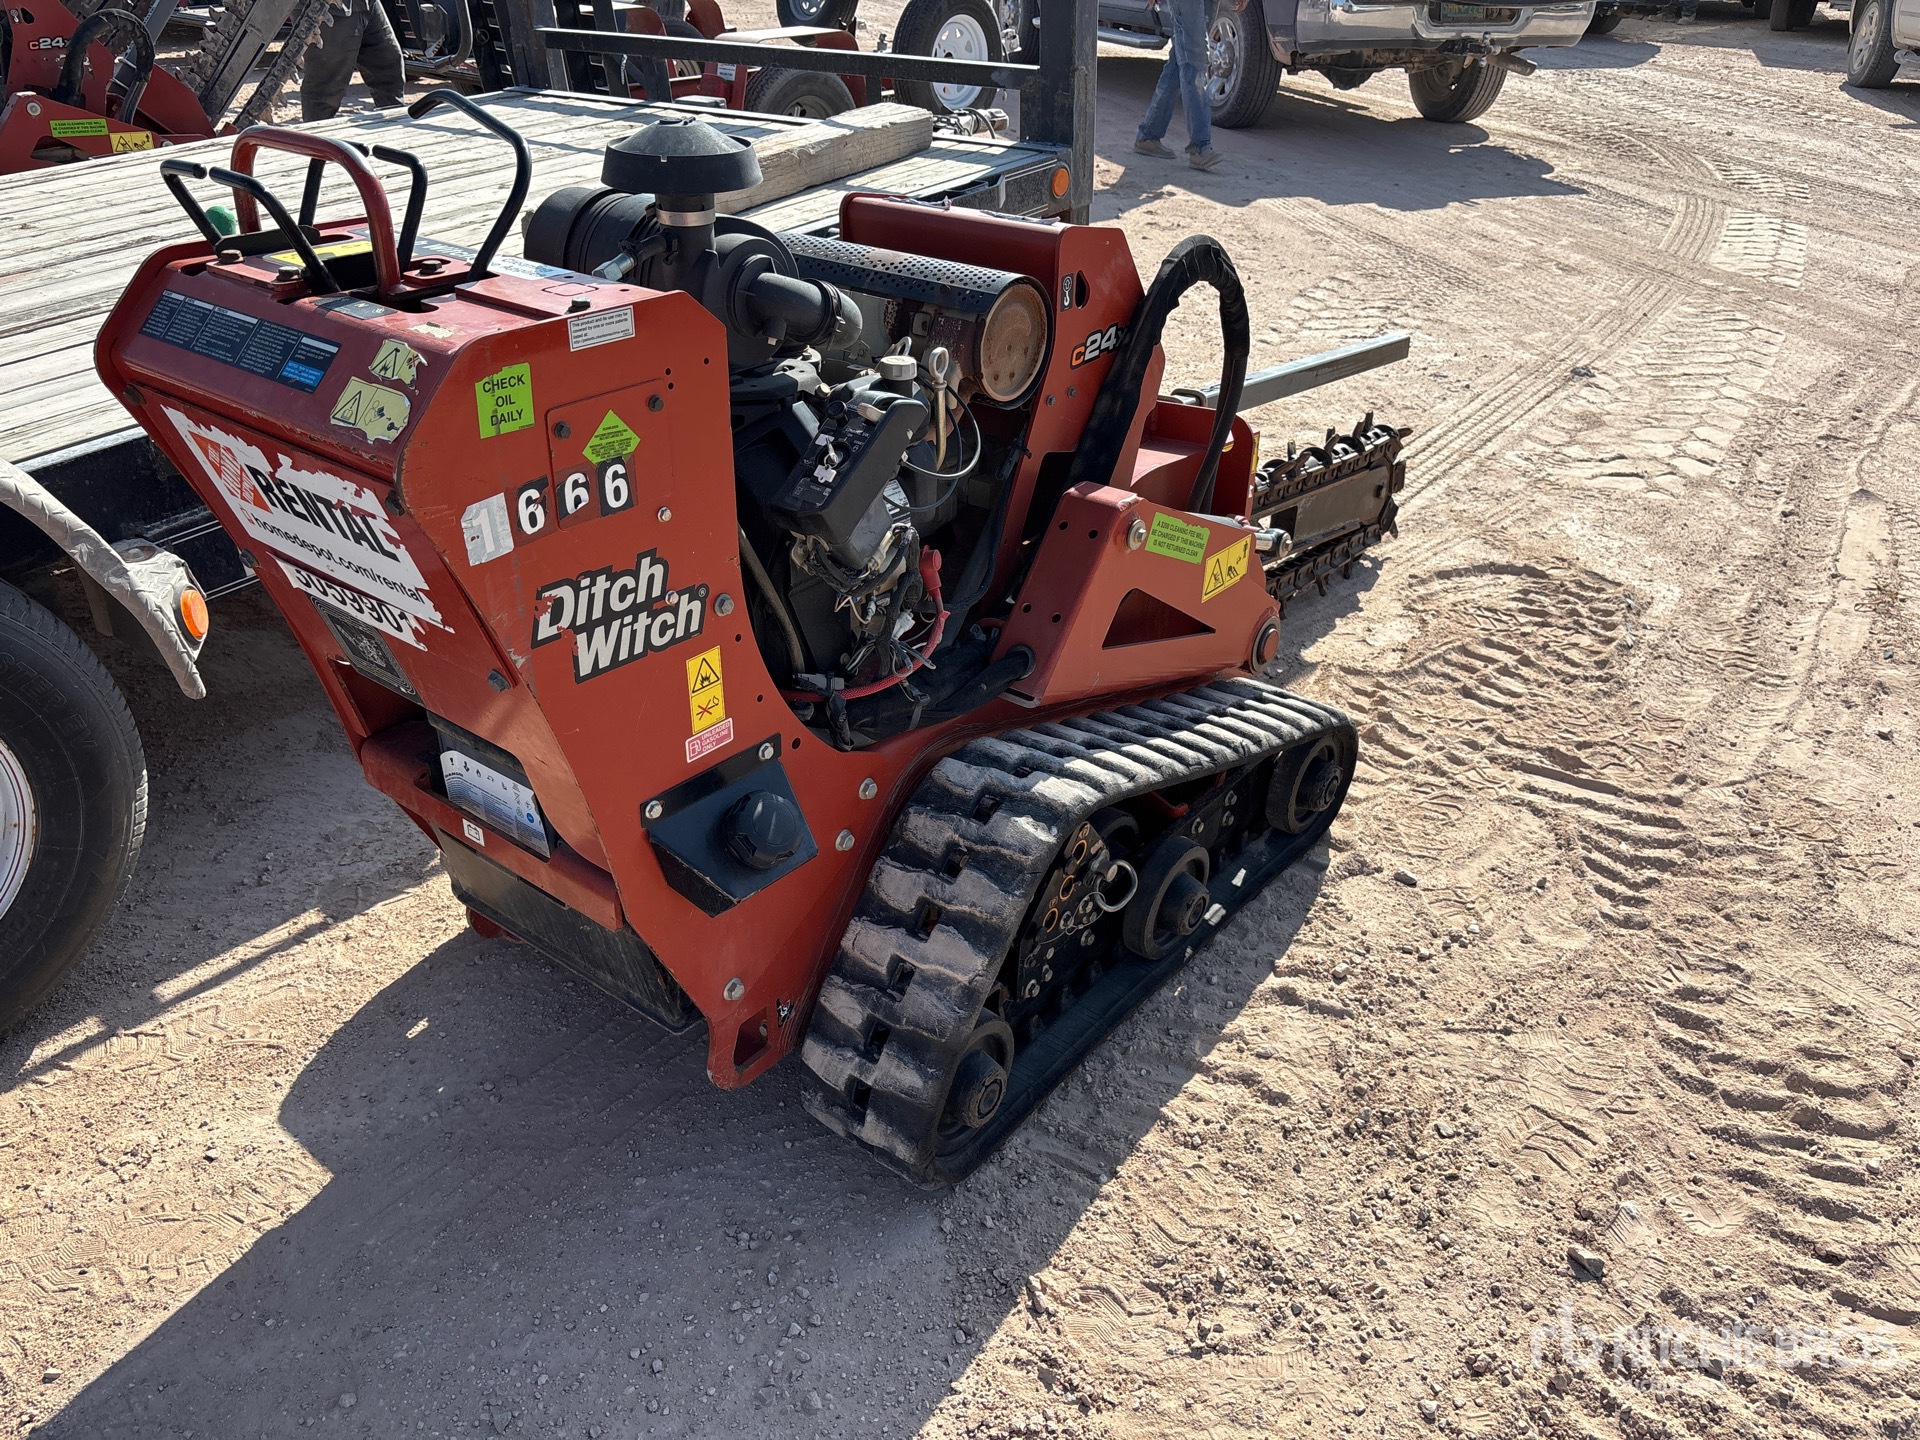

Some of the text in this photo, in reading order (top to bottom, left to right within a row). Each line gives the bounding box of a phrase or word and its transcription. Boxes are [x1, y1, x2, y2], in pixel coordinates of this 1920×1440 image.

[483, 374, 525, 393] CHECK
[496, 394, 516, 408] OIL
[491, 408, 524, 427] DAILY
[245, 464, 401, 562] RENTAL
[1157, 530, 1176, 541] CHARGED
[1179, 537, 1189, 545] THIS
[1188, 540, 1205, 550] MACHINE
[1169, 524, 1189, 535] CLEANING
[1195, 532, 1205, 540] WILL
[254, 512, 424, 604] homedepot.com/rental
[1157, 540, 1166, 548] NOT
[1166, 543, 1186, 554] RETURNED
[1185, 548, 1198, 557] CLEAN
[537, 557, 664, 640] Ditch
[576, 594, 701, 677] Witch
[701, 722, 730, 740] UNLEADED
[702, 728, 729, 746] GASOLINE
[702, 741, 717, 752] ONLY
